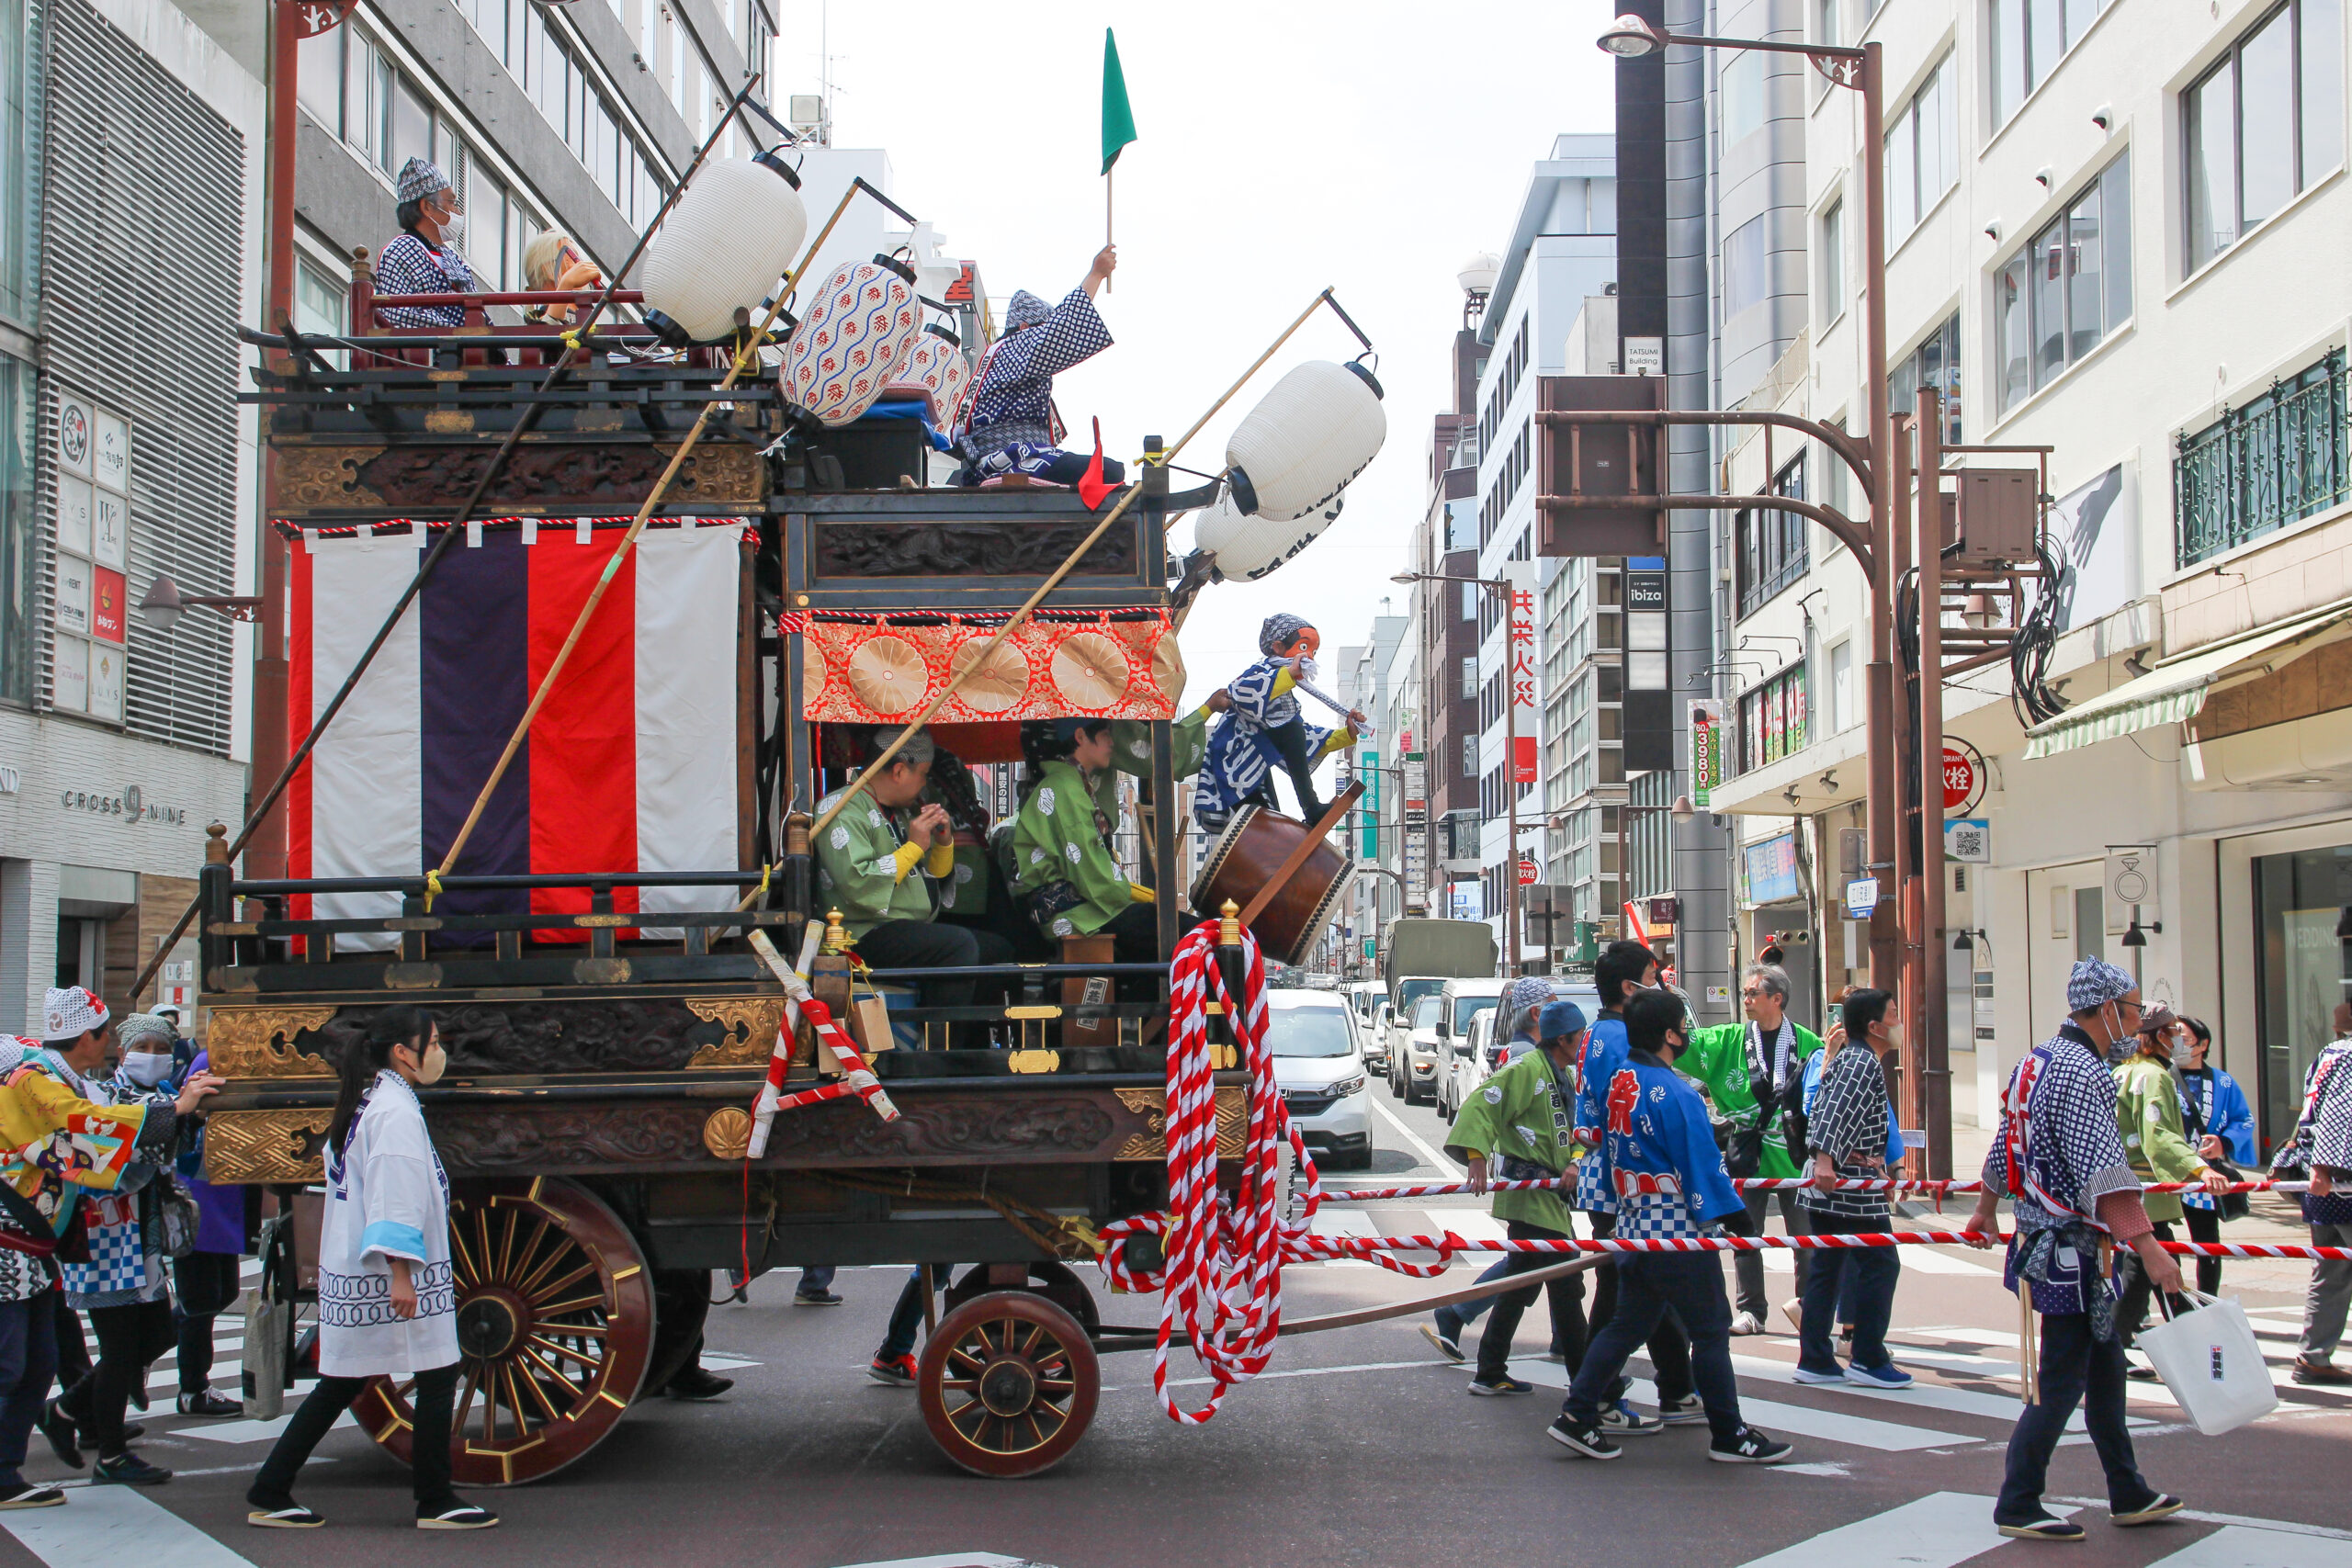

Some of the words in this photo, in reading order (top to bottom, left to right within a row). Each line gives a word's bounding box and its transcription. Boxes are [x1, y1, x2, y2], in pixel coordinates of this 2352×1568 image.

[875, 315, 888, 333] 祭
[1629, 357, 1657, 366] Building
[828, 384, 844, 402] 祭
[1631, 589, 1661, 601] ibiza
[1511, 589, 1534, 708] 共栄火災
[62, 790, 122, 815] CROSS
[125, 784, 141, 824] 9
[148, 804, 186, 825] NINE
[2285, 926, 2339, 949] WEDDING
